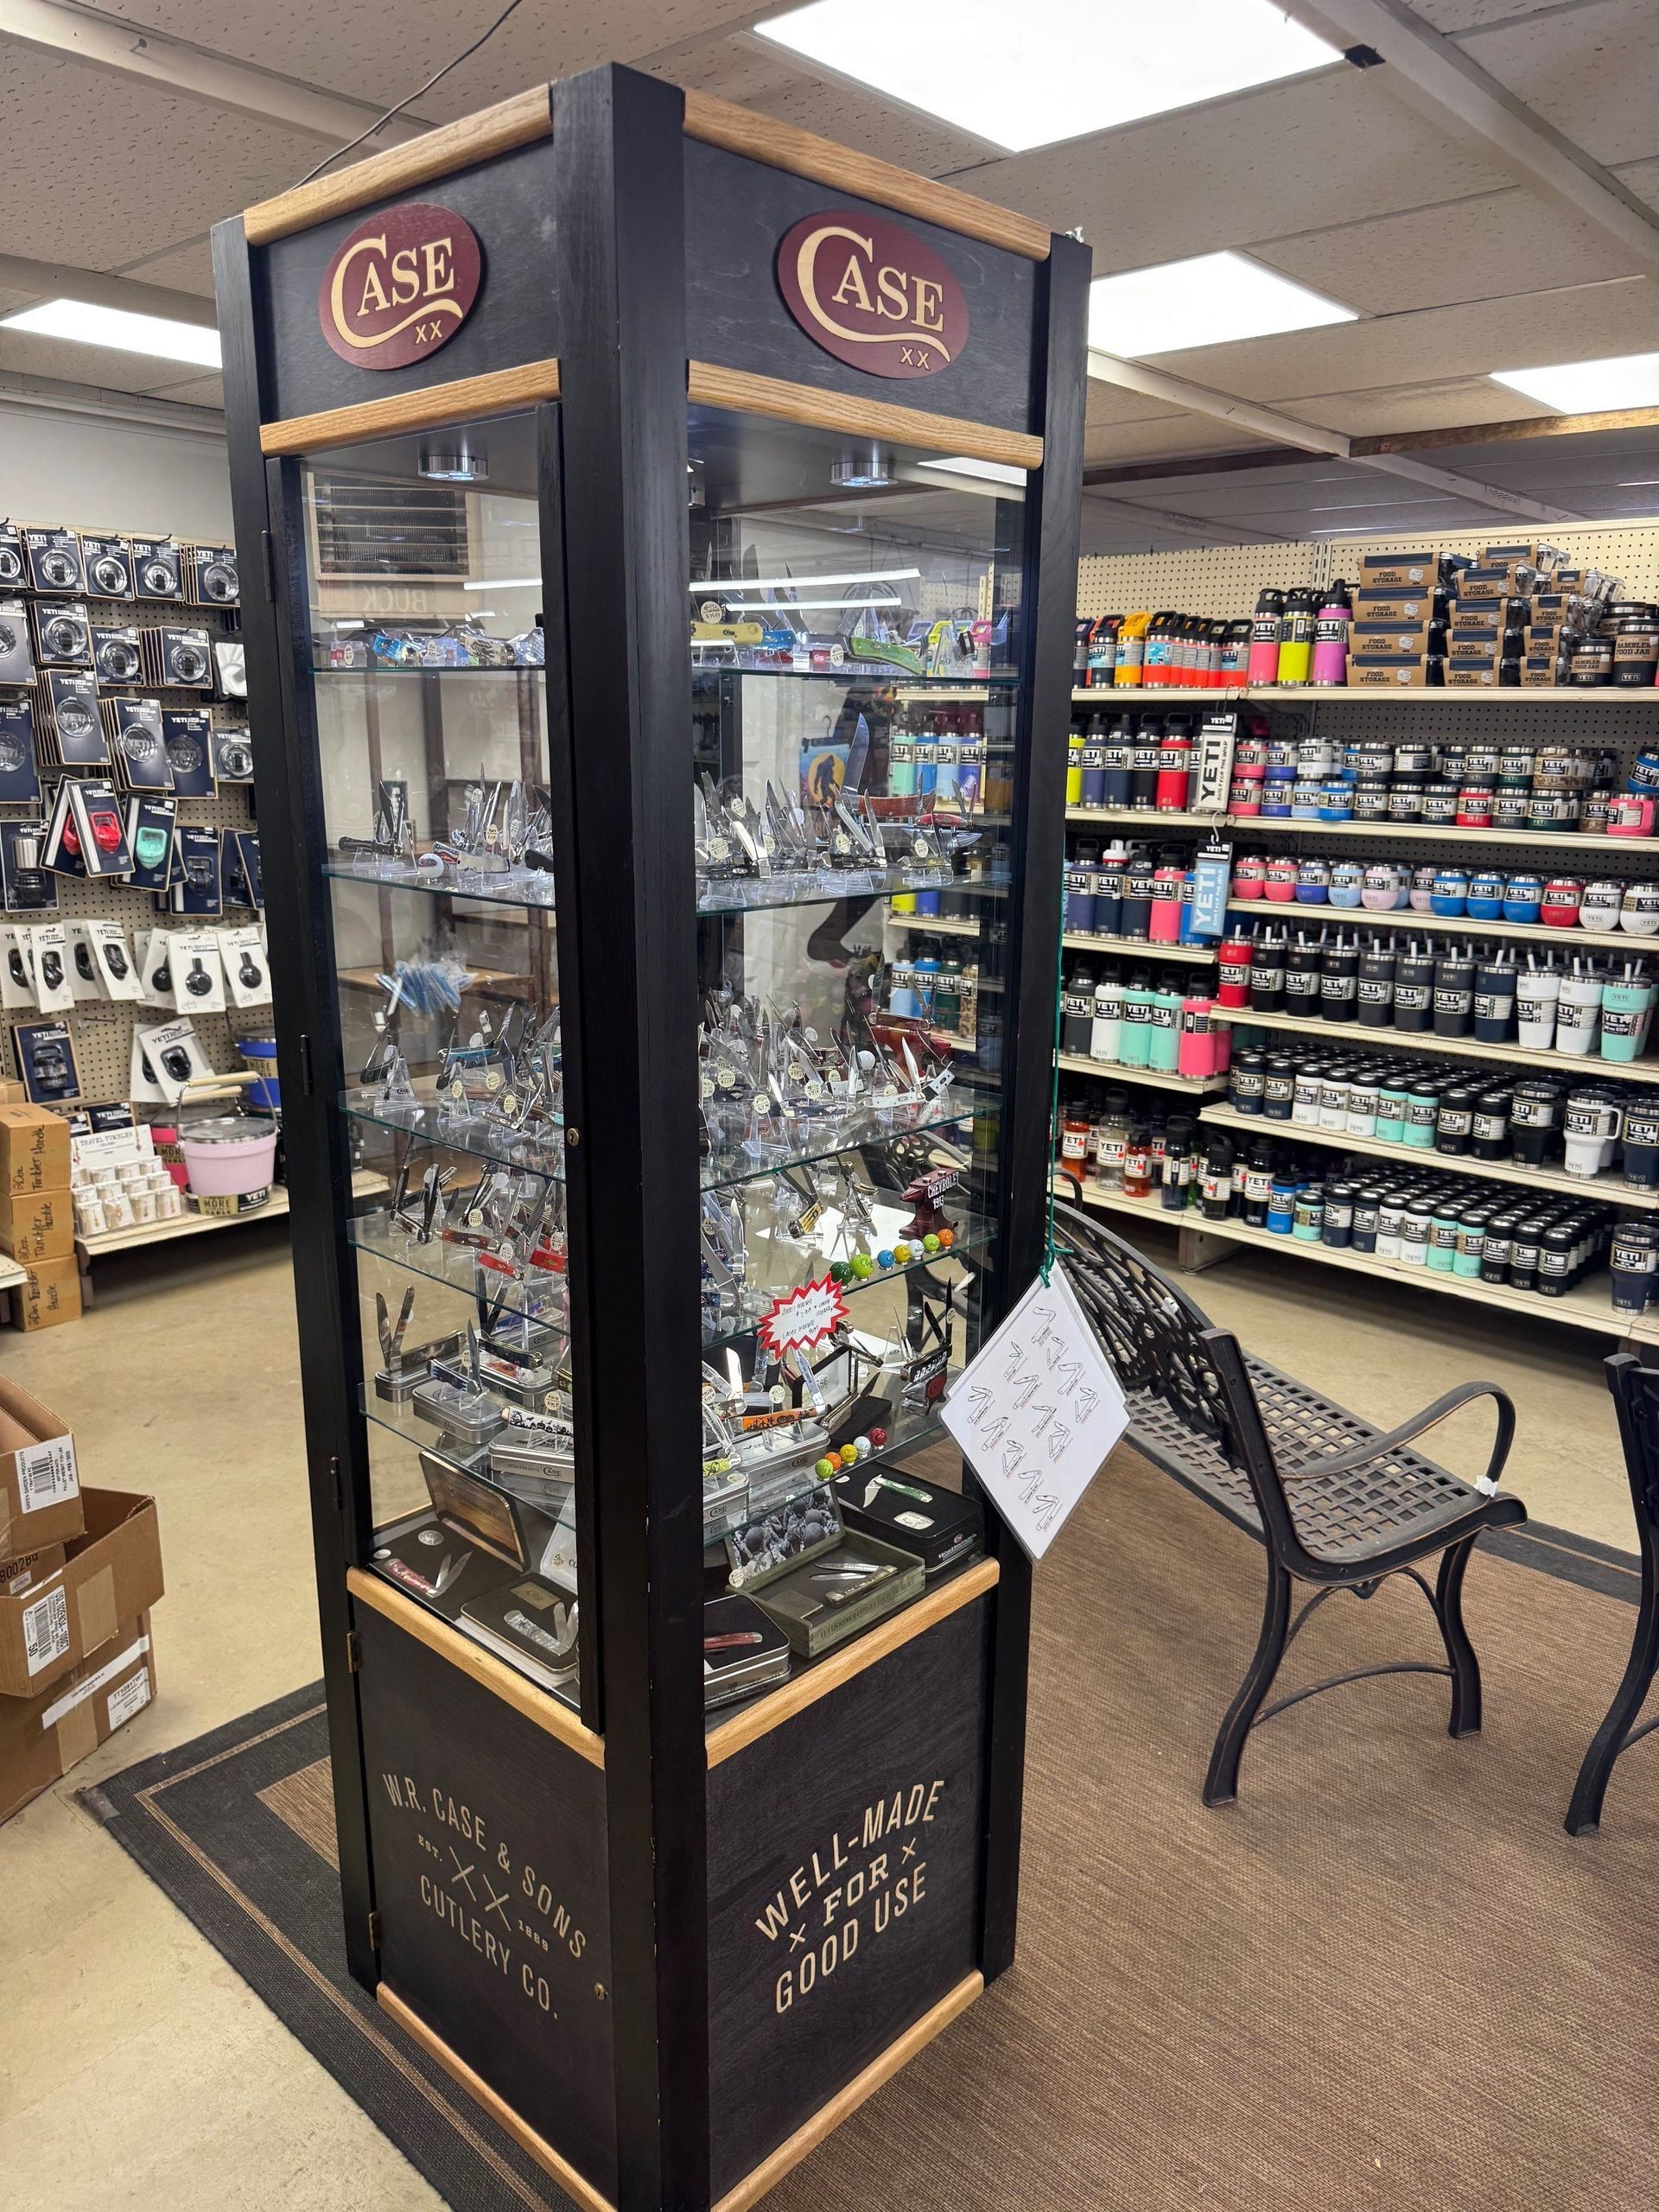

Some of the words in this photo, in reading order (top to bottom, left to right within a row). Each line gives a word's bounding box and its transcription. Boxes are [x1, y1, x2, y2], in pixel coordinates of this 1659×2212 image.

[331, 234, 462, 347] CASE
[797, 226, 950, 363] CASE
[415, 321, 443, 345] XX
[899, 346, 930, 370] XX
[84, 541, 100, 550] YETI
[1317, 620, 1338, 631] YETI
[1468, 757, 1486, 766] YETI
[1503, 759, 1521, 767] YETI
[1543, 759, 1564, 767] YETI
[1201, 740, 1220, 802] YETI
[1196, 868, 1215, 926] YETI
[1220, 966, 1239, 975] YETI
[914, 974, 933, 982] YETI
[1360, 982, 1381, 990] YETI
[1396, 987, 1417, 996] YETI
[1436, 992, 1459, 1001] YETI
[1096, 1001, 1118, 1010] YETI
[1127, 1004, 1150, 1014] YETI
[152, 1033, 171, 1044] YETI
[1268, 1080, 1284, 1089] YETI
[1414, 1106, 1433, 1115] YETI
[1512, 1103, 1529, 1113] YETI
[1441, 1112, 1460, 1121] YETI
[1567, 1113, 1590, 1123] YETI
[1630, 1122, 1655, 1134] YETI
[1101, 1141, 1123, 1151] YETI
[927, 1173, 959, 1199] CHEVROLET
[245, 1189, 266, 1201] YETI
[204, 1198, 231, 1208] MORE
[933, 1197, 945, 1210] 1913
[1616, 1249, 1639, 1261] YETI
[543, 1465, 562, 1478] CASE
[28, 1643, 37, 1657] 50
[417, 1834, 442, 1863] EST.
[382, 1773, 426, 1814] W.R.
[432, 1787, 487, 1852] CASE
[498, 1842, 511, 1877] &
[522, 1865, 586, 1959] SONS
[755, 1780, 945, 1944] WELL-MADE
[823, 1859, 888, 1927] FOR
[518, 1920, 550, 1952] 1889
[775, 1918, 860, 2014] GOOD
[874, 1861, 928, 1935] USE
[420, 1876, 511, 1976] CUTLERY
[522, 1962, 559, 2020] CO.
